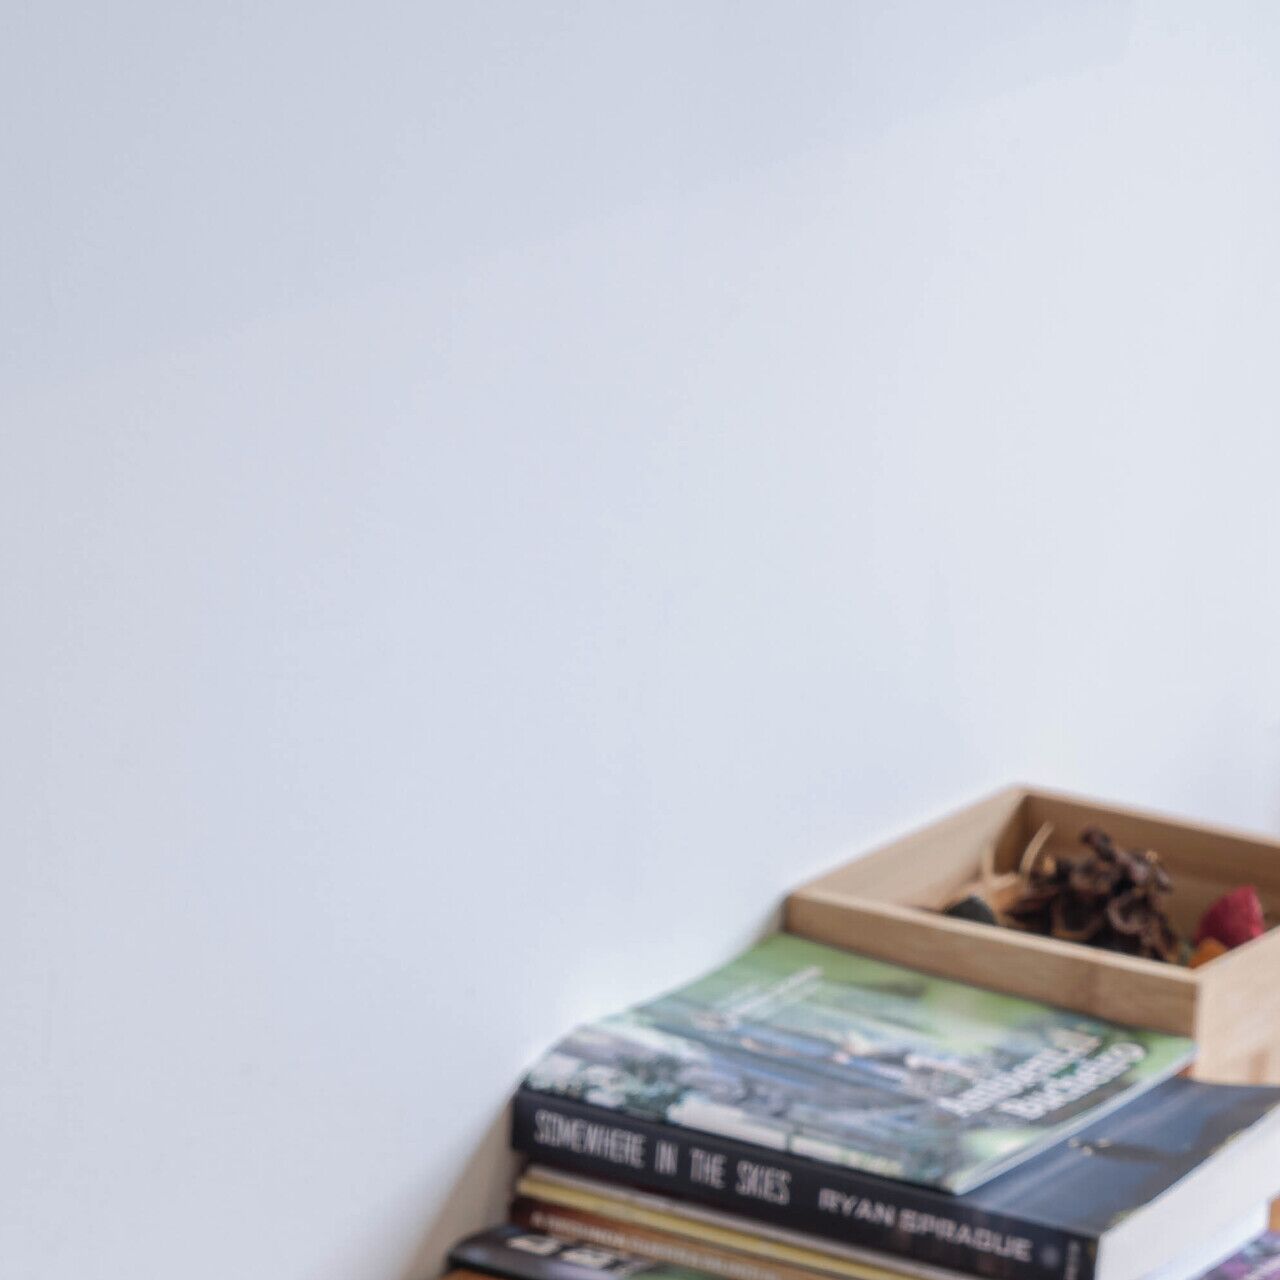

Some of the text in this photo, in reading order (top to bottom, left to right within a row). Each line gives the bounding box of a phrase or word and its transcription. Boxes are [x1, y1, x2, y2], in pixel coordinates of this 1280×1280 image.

[534, 1108, 1033, 1263] SOMEWHERE IN THE SKIES RYAN SPRAGUE
